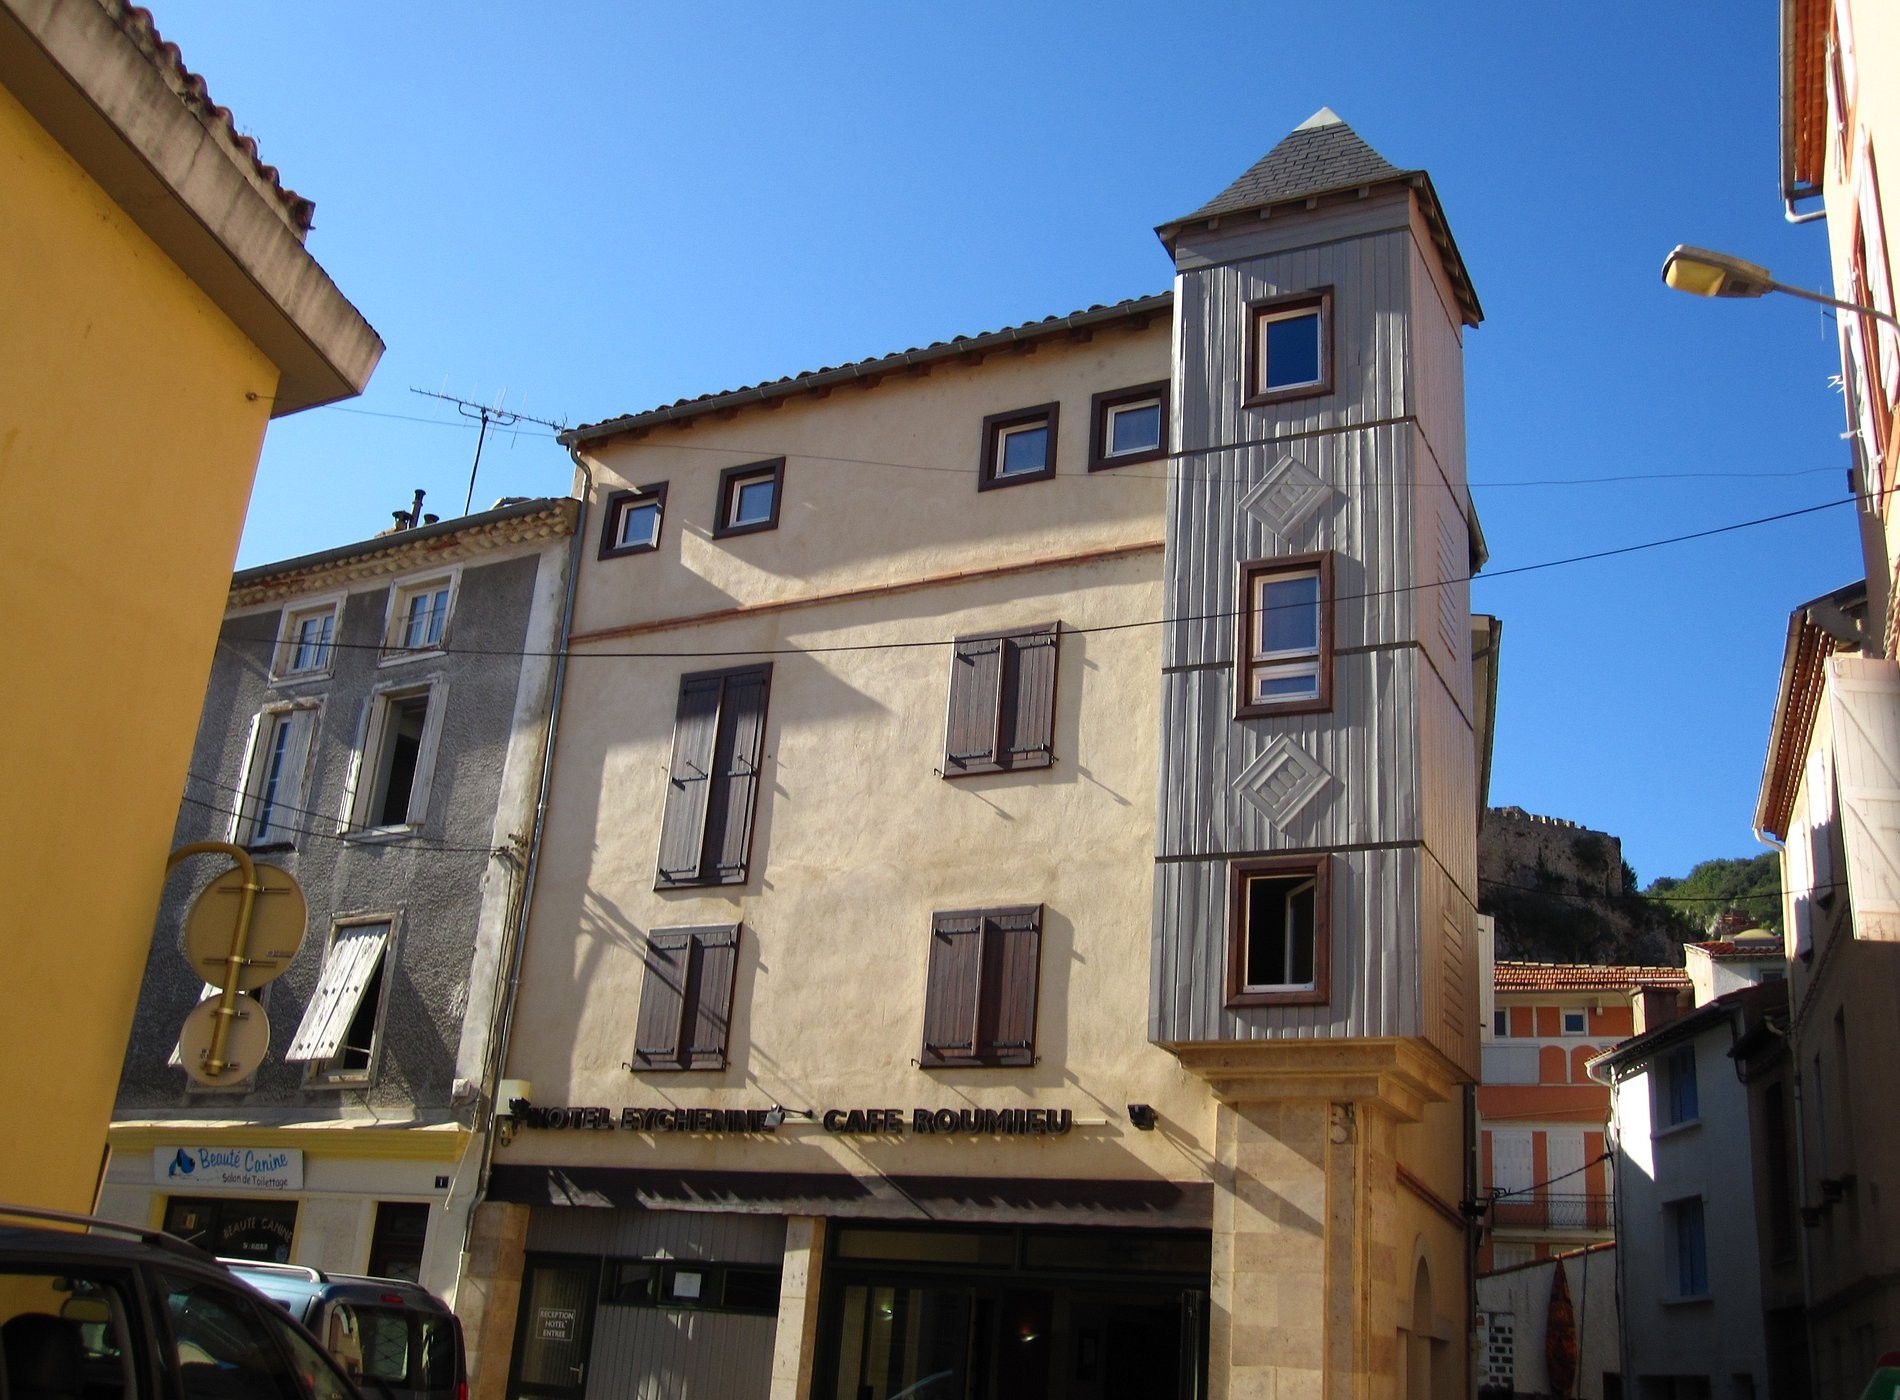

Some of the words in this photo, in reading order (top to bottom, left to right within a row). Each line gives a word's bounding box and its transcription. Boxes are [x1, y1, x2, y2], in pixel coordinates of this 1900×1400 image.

[527, 1107, 614, 1131] HOTEL
[823, 1109, 904, 1134] CAFE
[912, 1109, 1072, 1135] ROUMIEU
[198, 1148, 241, 1169] Beauté
[245, 1150, 288, 1173] Canine
[222, 1173, 242, 1184] Salon
[242, 1174, 250, 1184] de
[252, 1175, 288, 1189] Toilettage
